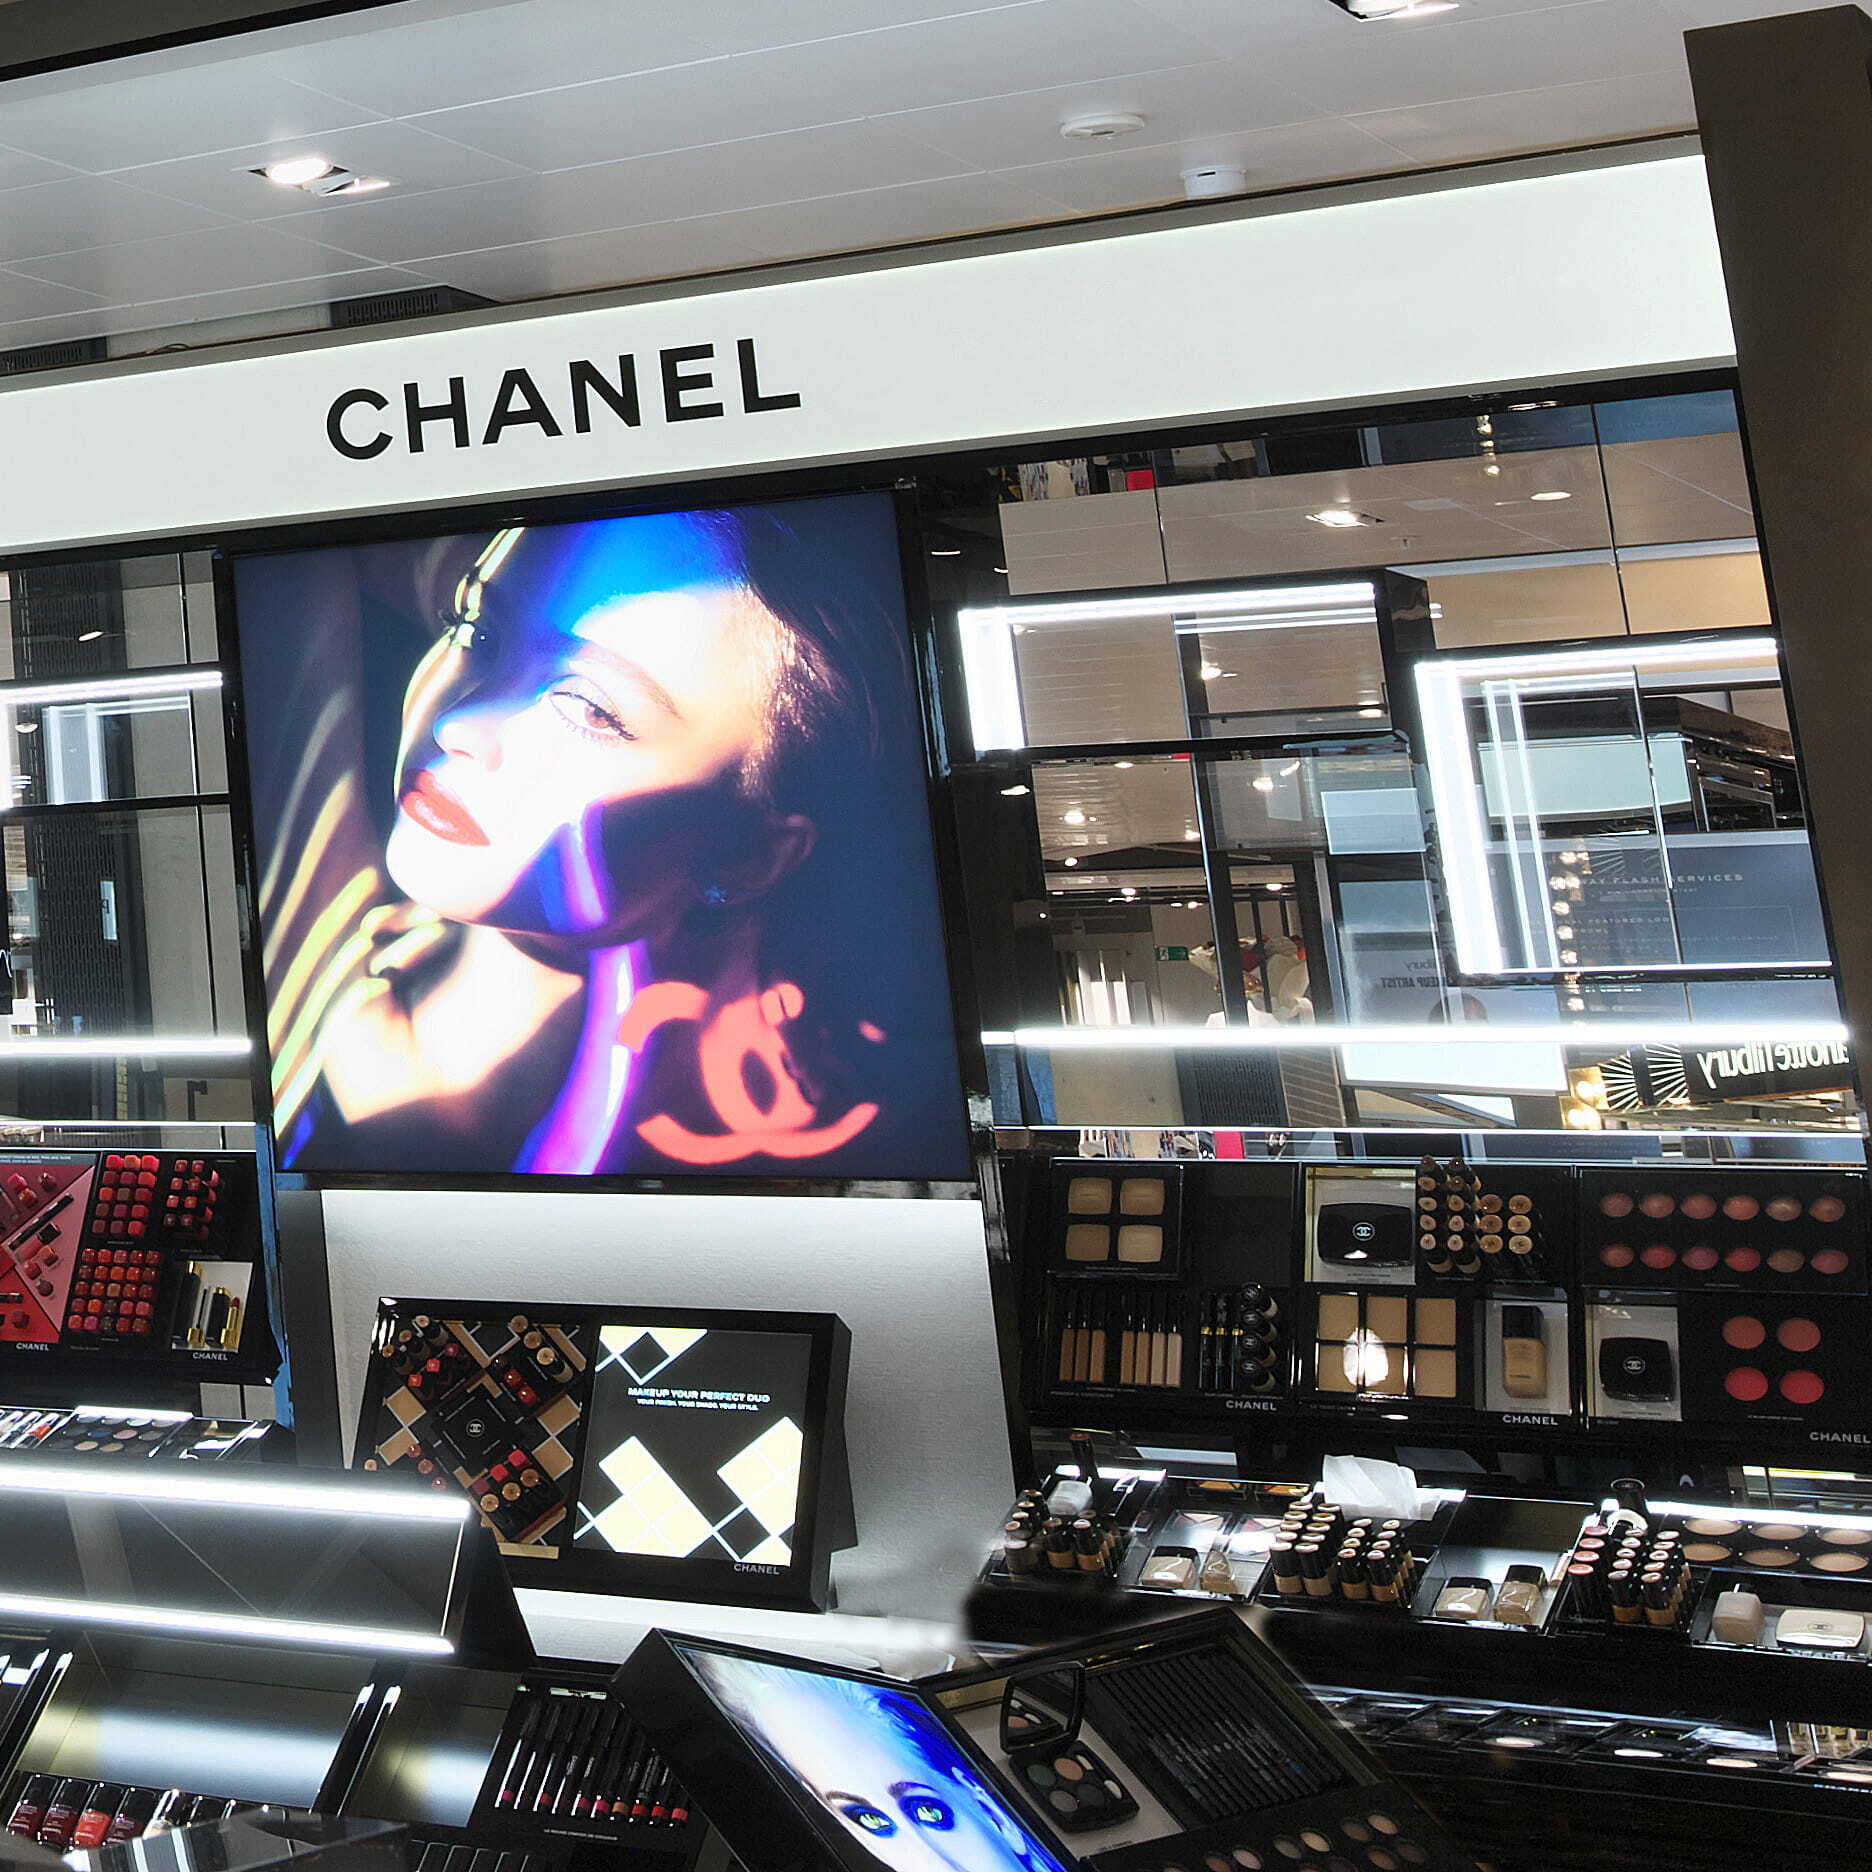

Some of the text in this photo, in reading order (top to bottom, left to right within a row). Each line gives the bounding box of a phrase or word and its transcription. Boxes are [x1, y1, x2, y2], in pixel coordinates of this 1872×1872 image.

[327, 338, 802, 460] CHANEL
[1670, 874, 1744, 883] ERVICES
[16, 1342, 50, 1352] CHANEL
[192, 1351, 229, 1361] CHANEL
[628, 1387, 771, 1403] MAKEUP YOUR PERFECT DUO
[1226, 1399, 1277, 1411] CHANEL
[1502, 1414, 1559, 1426] CHANEL
[1809, 1431, 1872, 1444] CHANEL
[734, 1564, 780, 1576] CHANEL
